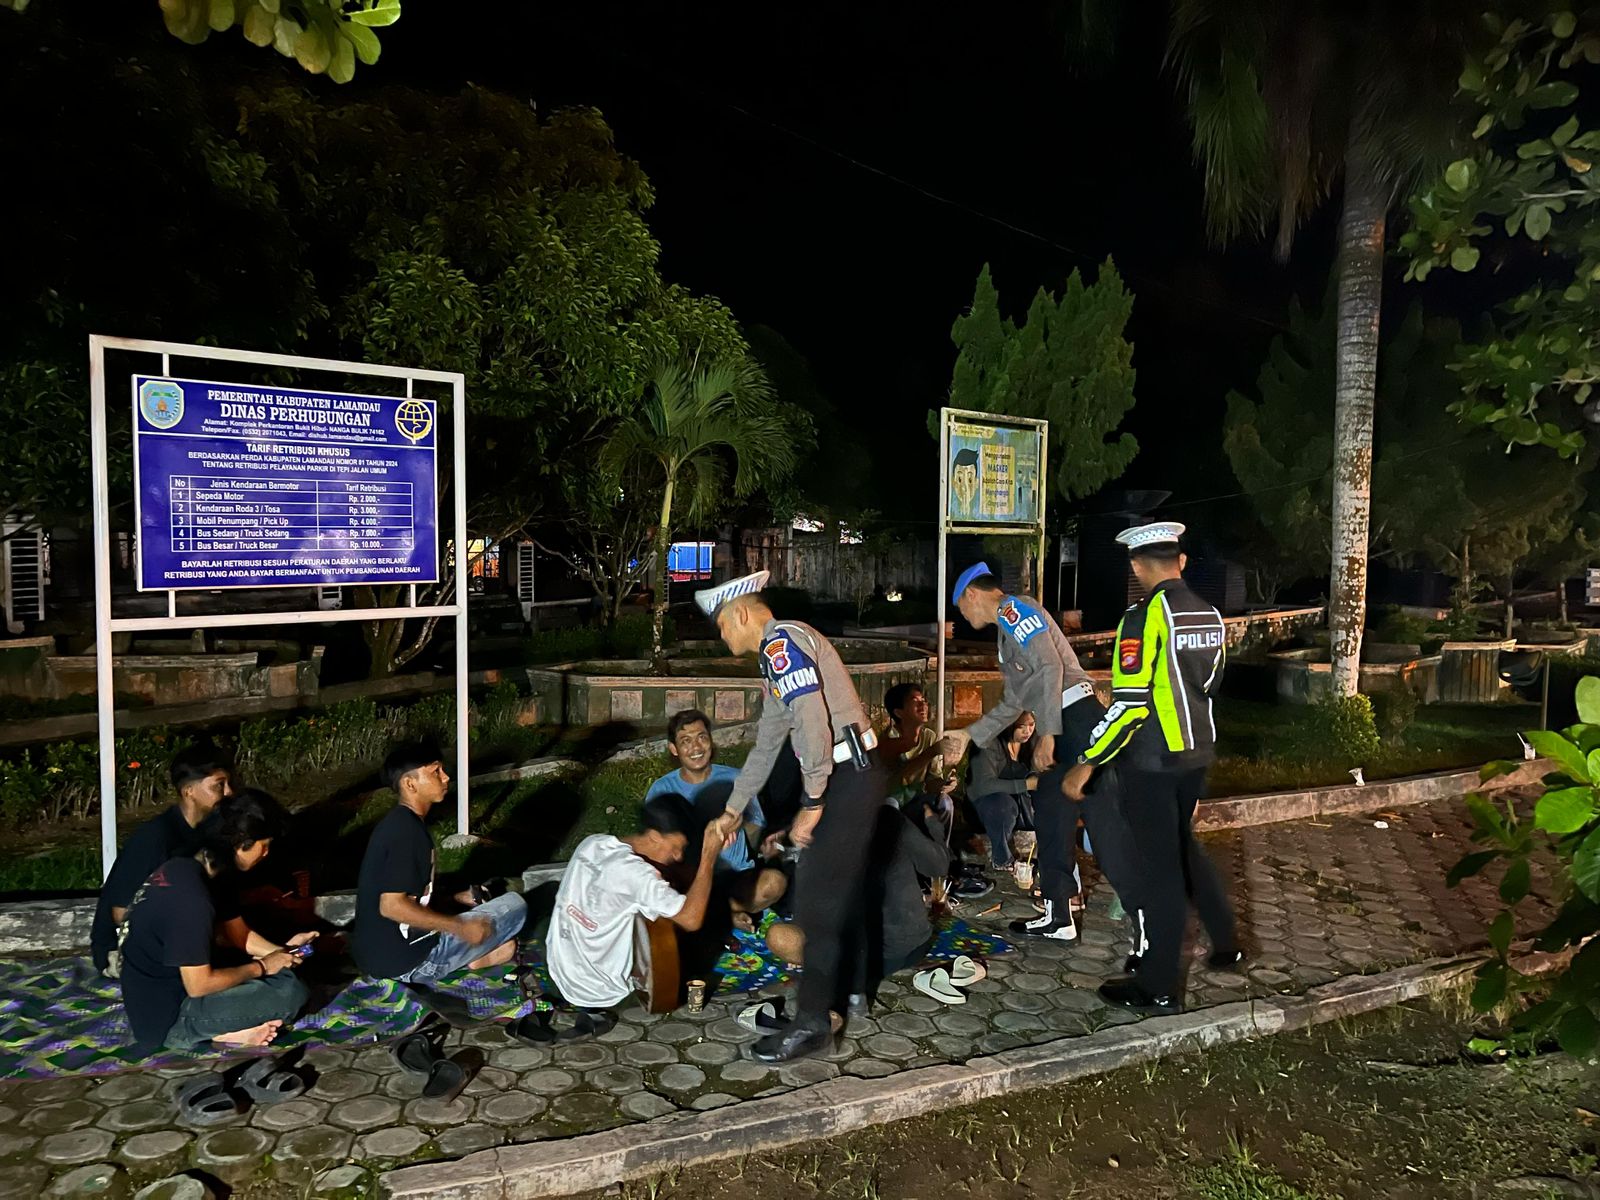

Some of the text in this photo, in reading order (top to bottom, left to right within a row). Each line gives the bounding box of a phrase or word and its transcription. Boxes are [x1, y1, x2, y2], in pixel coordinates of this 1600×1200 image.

[207, 389, 381, 412] PEMERINTAH KABUPATEN LAMANDAU
[220, 403, 371, 427] DINAS PERHUBUNGAN
[258, 421, 294, 431] Perkantoran
[246, 443, 351, 457] TARIF RETRIBUSI KHUSUS
[188, 451, 240, 461] BERDASARKAN
[240, 454, 263, 462] PERDA
[263, 455, 300, 463] KABUPATEN
[335, 458, 358, 466] NOMOR
[202, 460, 234, 469] TENTANG
[234, 462, 269, 470] RETRIBUSI
[269, 463, 306, 471] PELAYANAN
[306, 465, 329, 473] PARKIR
[175, 478, 186, 488] No
[210, 480, 300, 490] Jenis Kendaraan Bermotor
[345, 483, 387, 493] Tarif Retribusi
[195, 491, 245, 501] Sepeda Motor
[348, 495, 359, 504] Rp.
[178, 503, 184, 512] 2
[195, 503, 235, 513] Kendaraan
[235, 504, 254, 513] Roda
[254, 505, 260, 513] 3
[264, 505, 281, 513] Tosa
[348, 506, 359, 516] Rp.
[178, 516, 184, 525] 3
[196, 516, 217, 525] Mobil
[217, 516, 259, 527] Penumpang
[263, 517, 278, 525] Pick
[279, 517, 289, 527] Up
[349, 517, 360, 527] Rp.
[178, 529, 185, 537] 4
[196, 529, 211, 537] Bus
[212, 529, 240, 539] Sedang
[243, 529, 263, 537] Truck
[264, 530, 290, 539] Sedang
[349, 529, 360, 539] Rp.
[179, 541, 185, 550] 5
[197, 541, 212, 550] Bus
[213, 541, 234, 549] Besar
[259, 541, 279, 549] Besar
[349, 540, 360, 550] Rp.
[181, 556, 408, 568] BAYARLAH RETRIBUSI SESUAI PERATURAN DAERAH YANG BERLAKU
[164, 565, 421, 580] RETRIBUSI YANG ANDA BAYAR BERMANFAAT UNTUK PEMBANGUNAN DAERAH
[1176, 631, 1221, 650] POLISI
